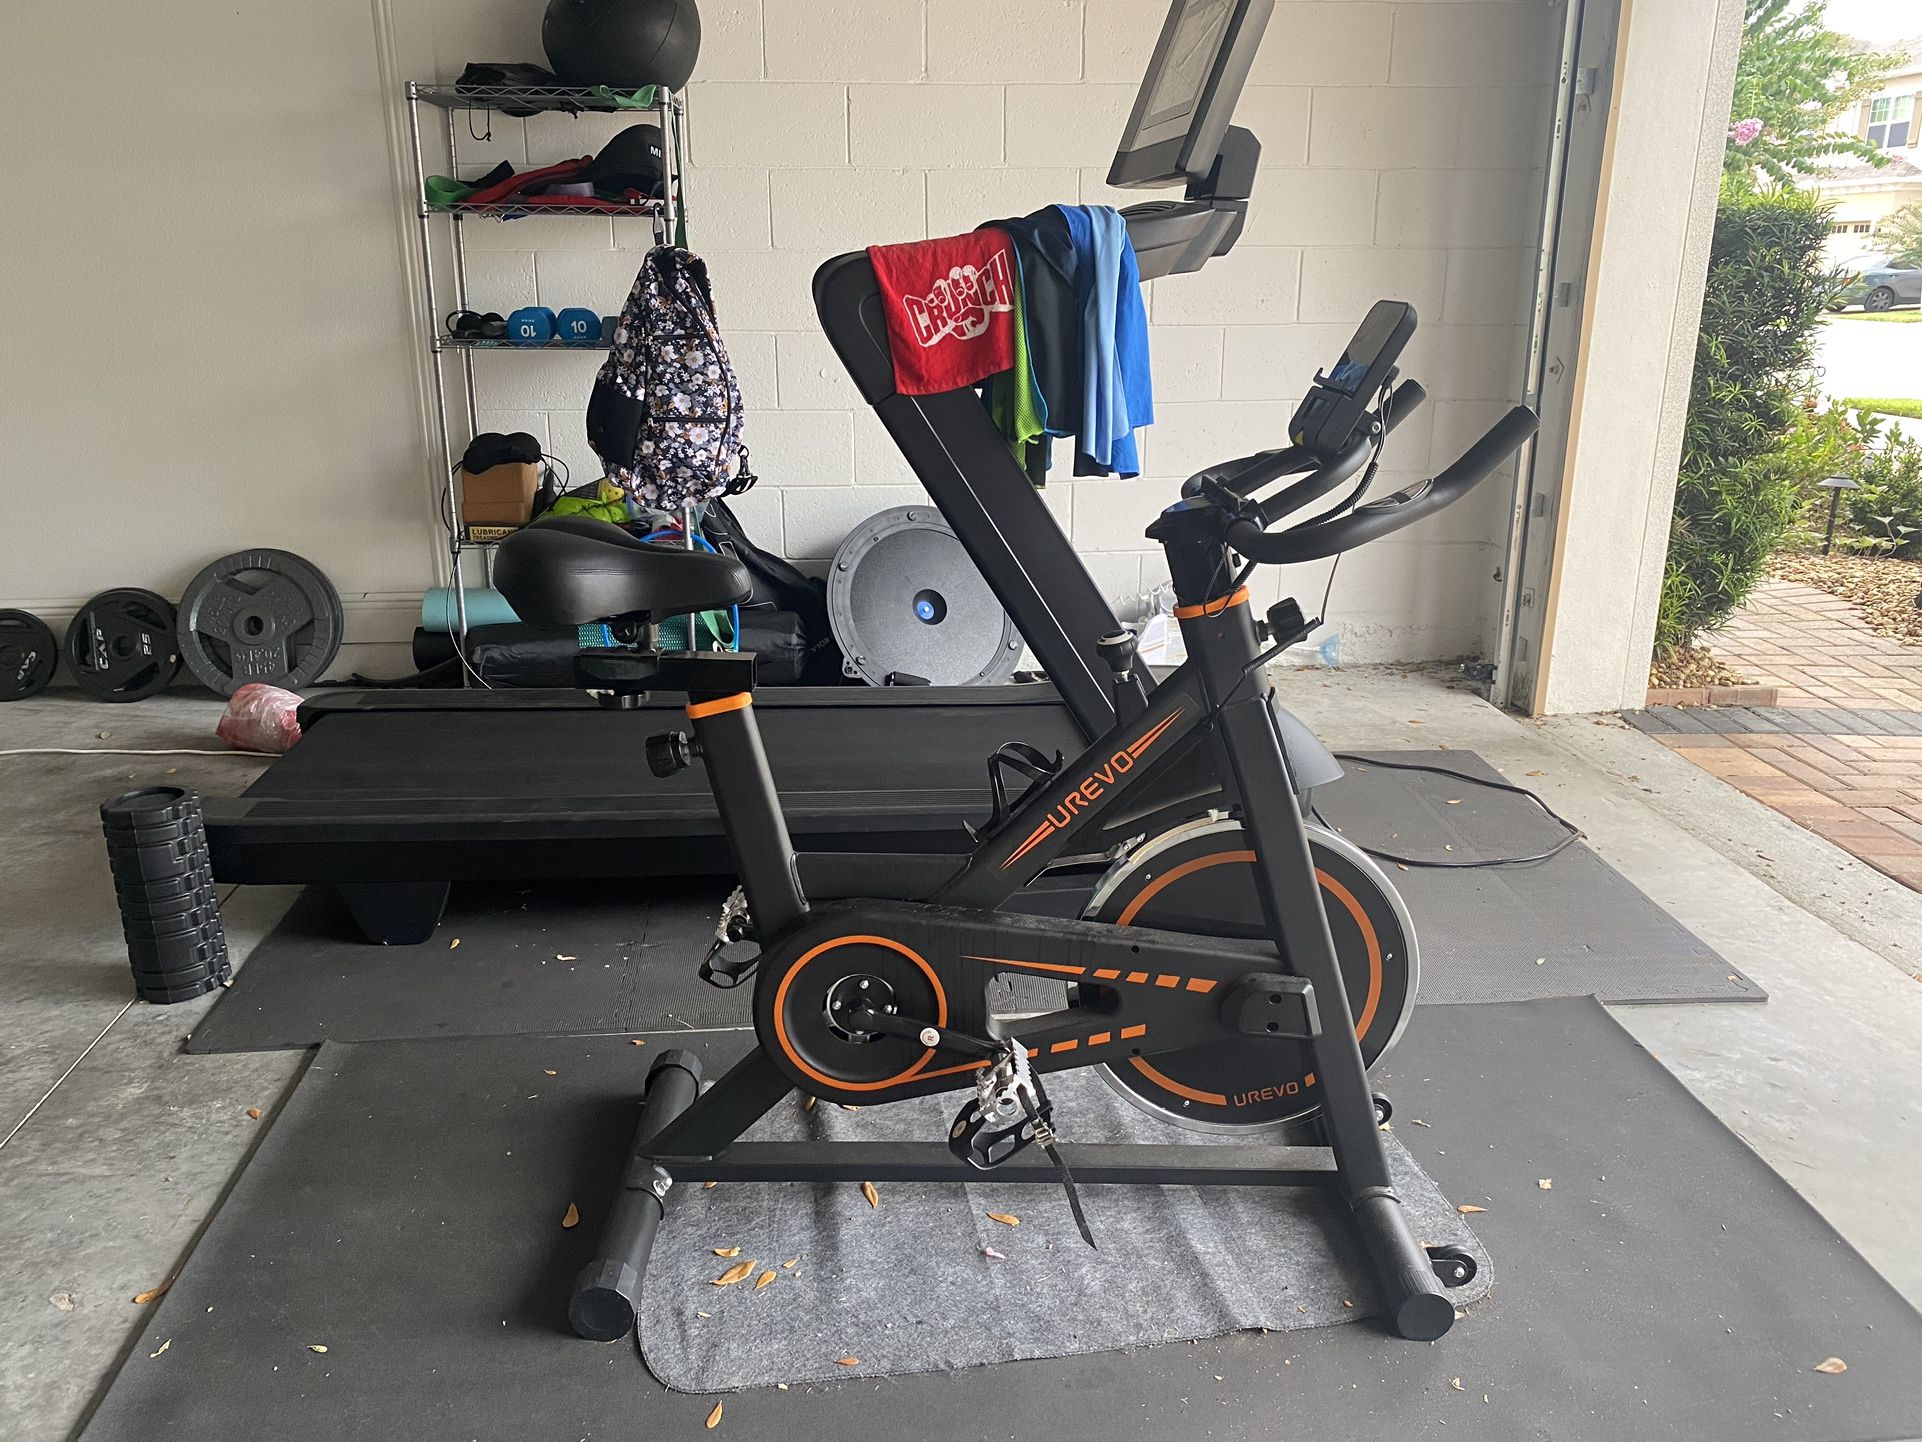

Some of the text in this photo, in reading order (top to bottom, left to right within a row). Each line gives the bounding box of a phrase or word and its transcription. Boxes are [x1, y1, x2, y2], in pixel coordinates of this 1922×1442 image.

[903, 248, 1014, 347] CRUNCH
[520, 324, 536, 337] 10
[571, 320, 587, 333] 10
[472, 528, 516, 536] LUBRICAN
[96, 628, 109, 669] CAP
[141, 633, 152, 656] 25
[1047, 751, 1134, 828] UREVO
[1233, 1082, 1299, 1107] UREVO
